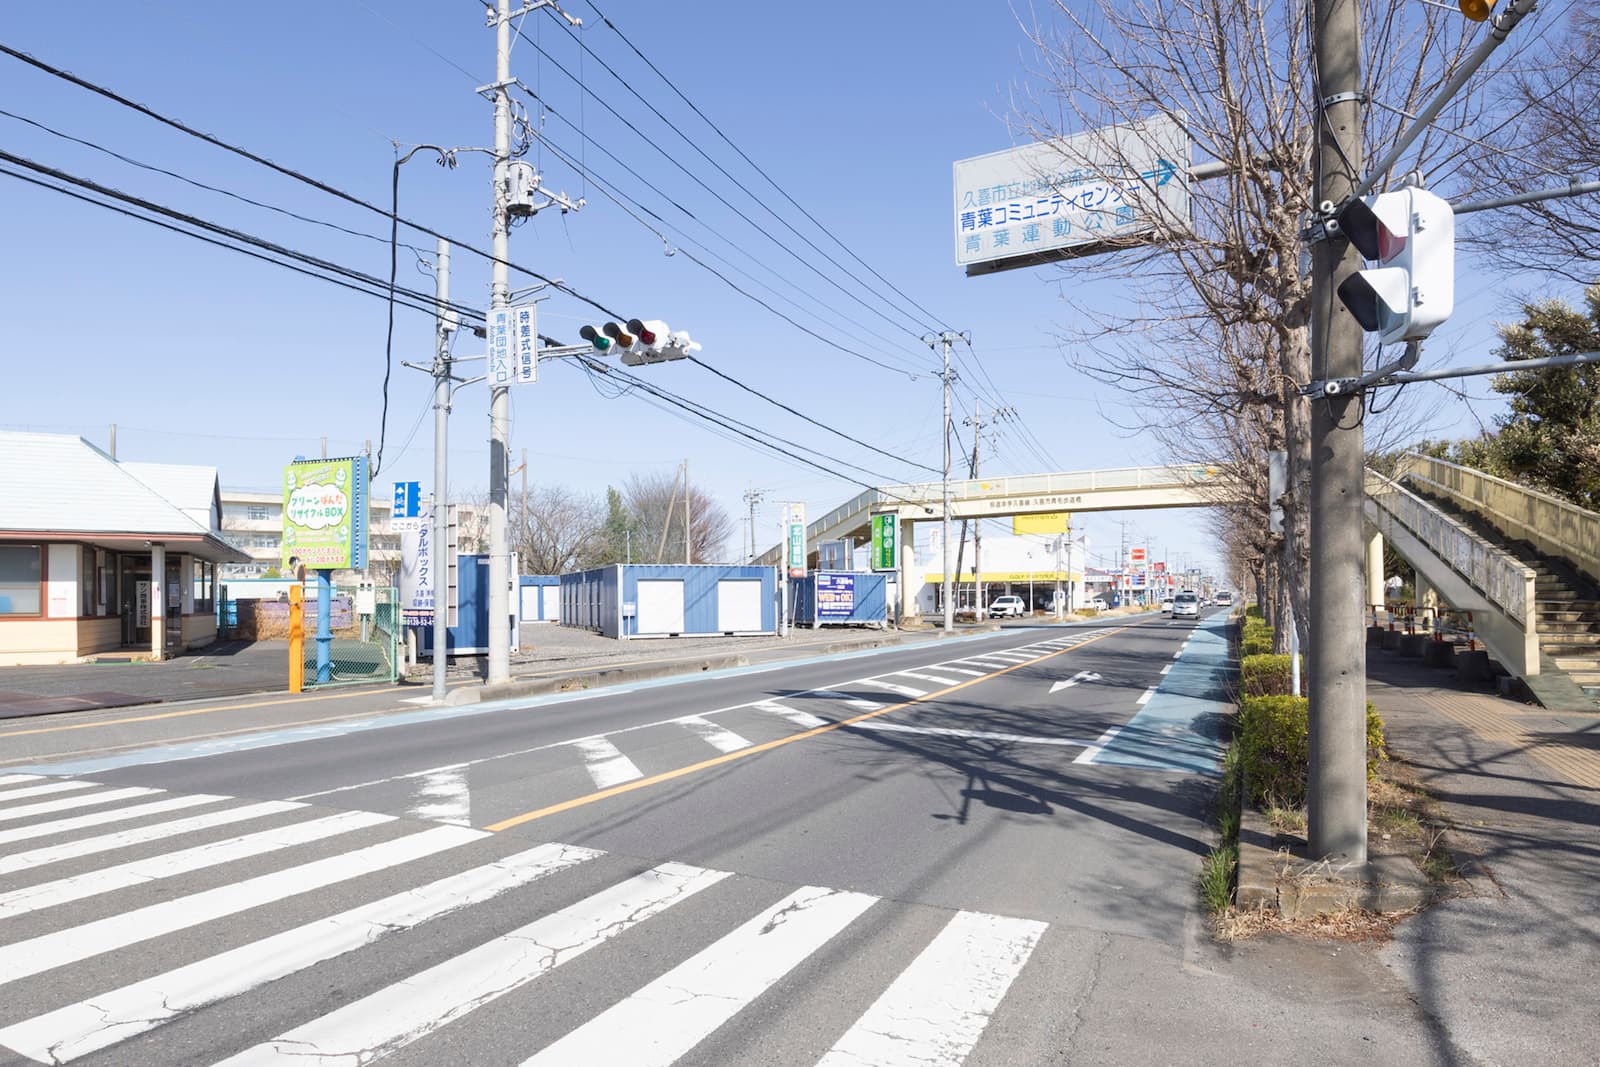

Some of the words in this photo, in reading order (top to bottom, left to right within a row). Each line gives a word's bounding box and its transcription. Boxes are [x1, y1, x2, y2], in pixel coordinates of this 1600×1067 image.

[960, 182, 1141, 232] 青葉コミュニティセンター
[965, 205, 1135, 254] 青葉運動公園
[496, 313, 507, 382] 青葉団地入口
[290, 507, 344, 519] リサイクルBOX
[391, 522, 419, 531] ここから
